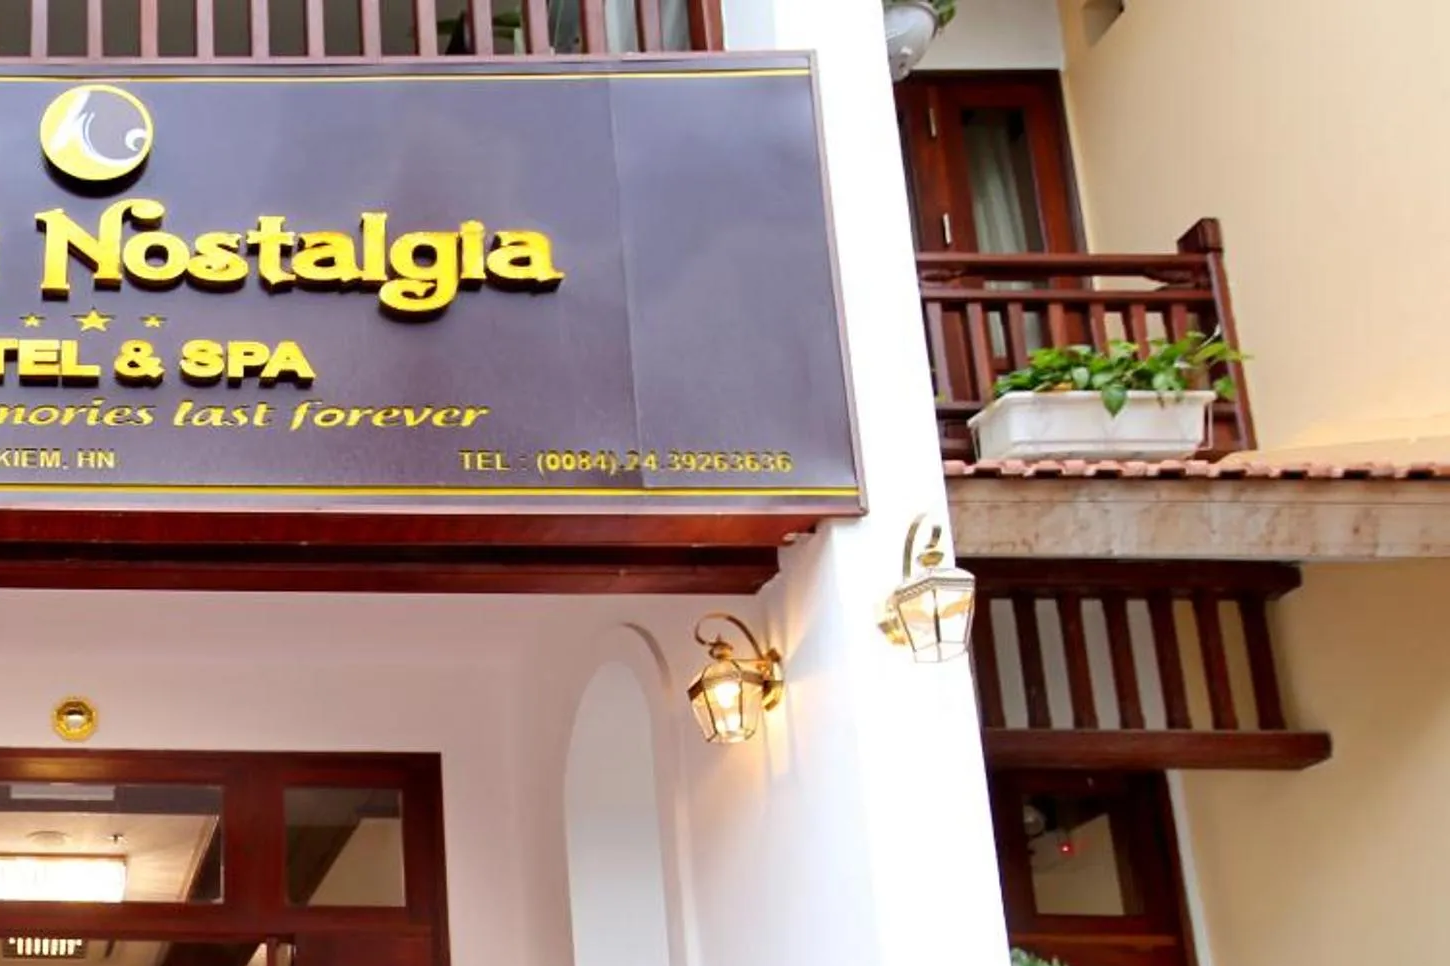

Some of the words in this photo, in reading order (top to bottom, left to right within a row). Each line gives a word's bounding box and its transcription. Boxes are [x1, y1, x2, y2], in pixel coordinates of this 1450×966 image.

[34, 199, 565, 320] Nostalgia
[113, 340, 164, 386] &
[179, 340, 316, 387] SPA
[173, 400, 274, 427] last
[289, 399, 491, 431] forever
[77, 448, 116, 469] HN
[458, 449, 511, 471] TEL
